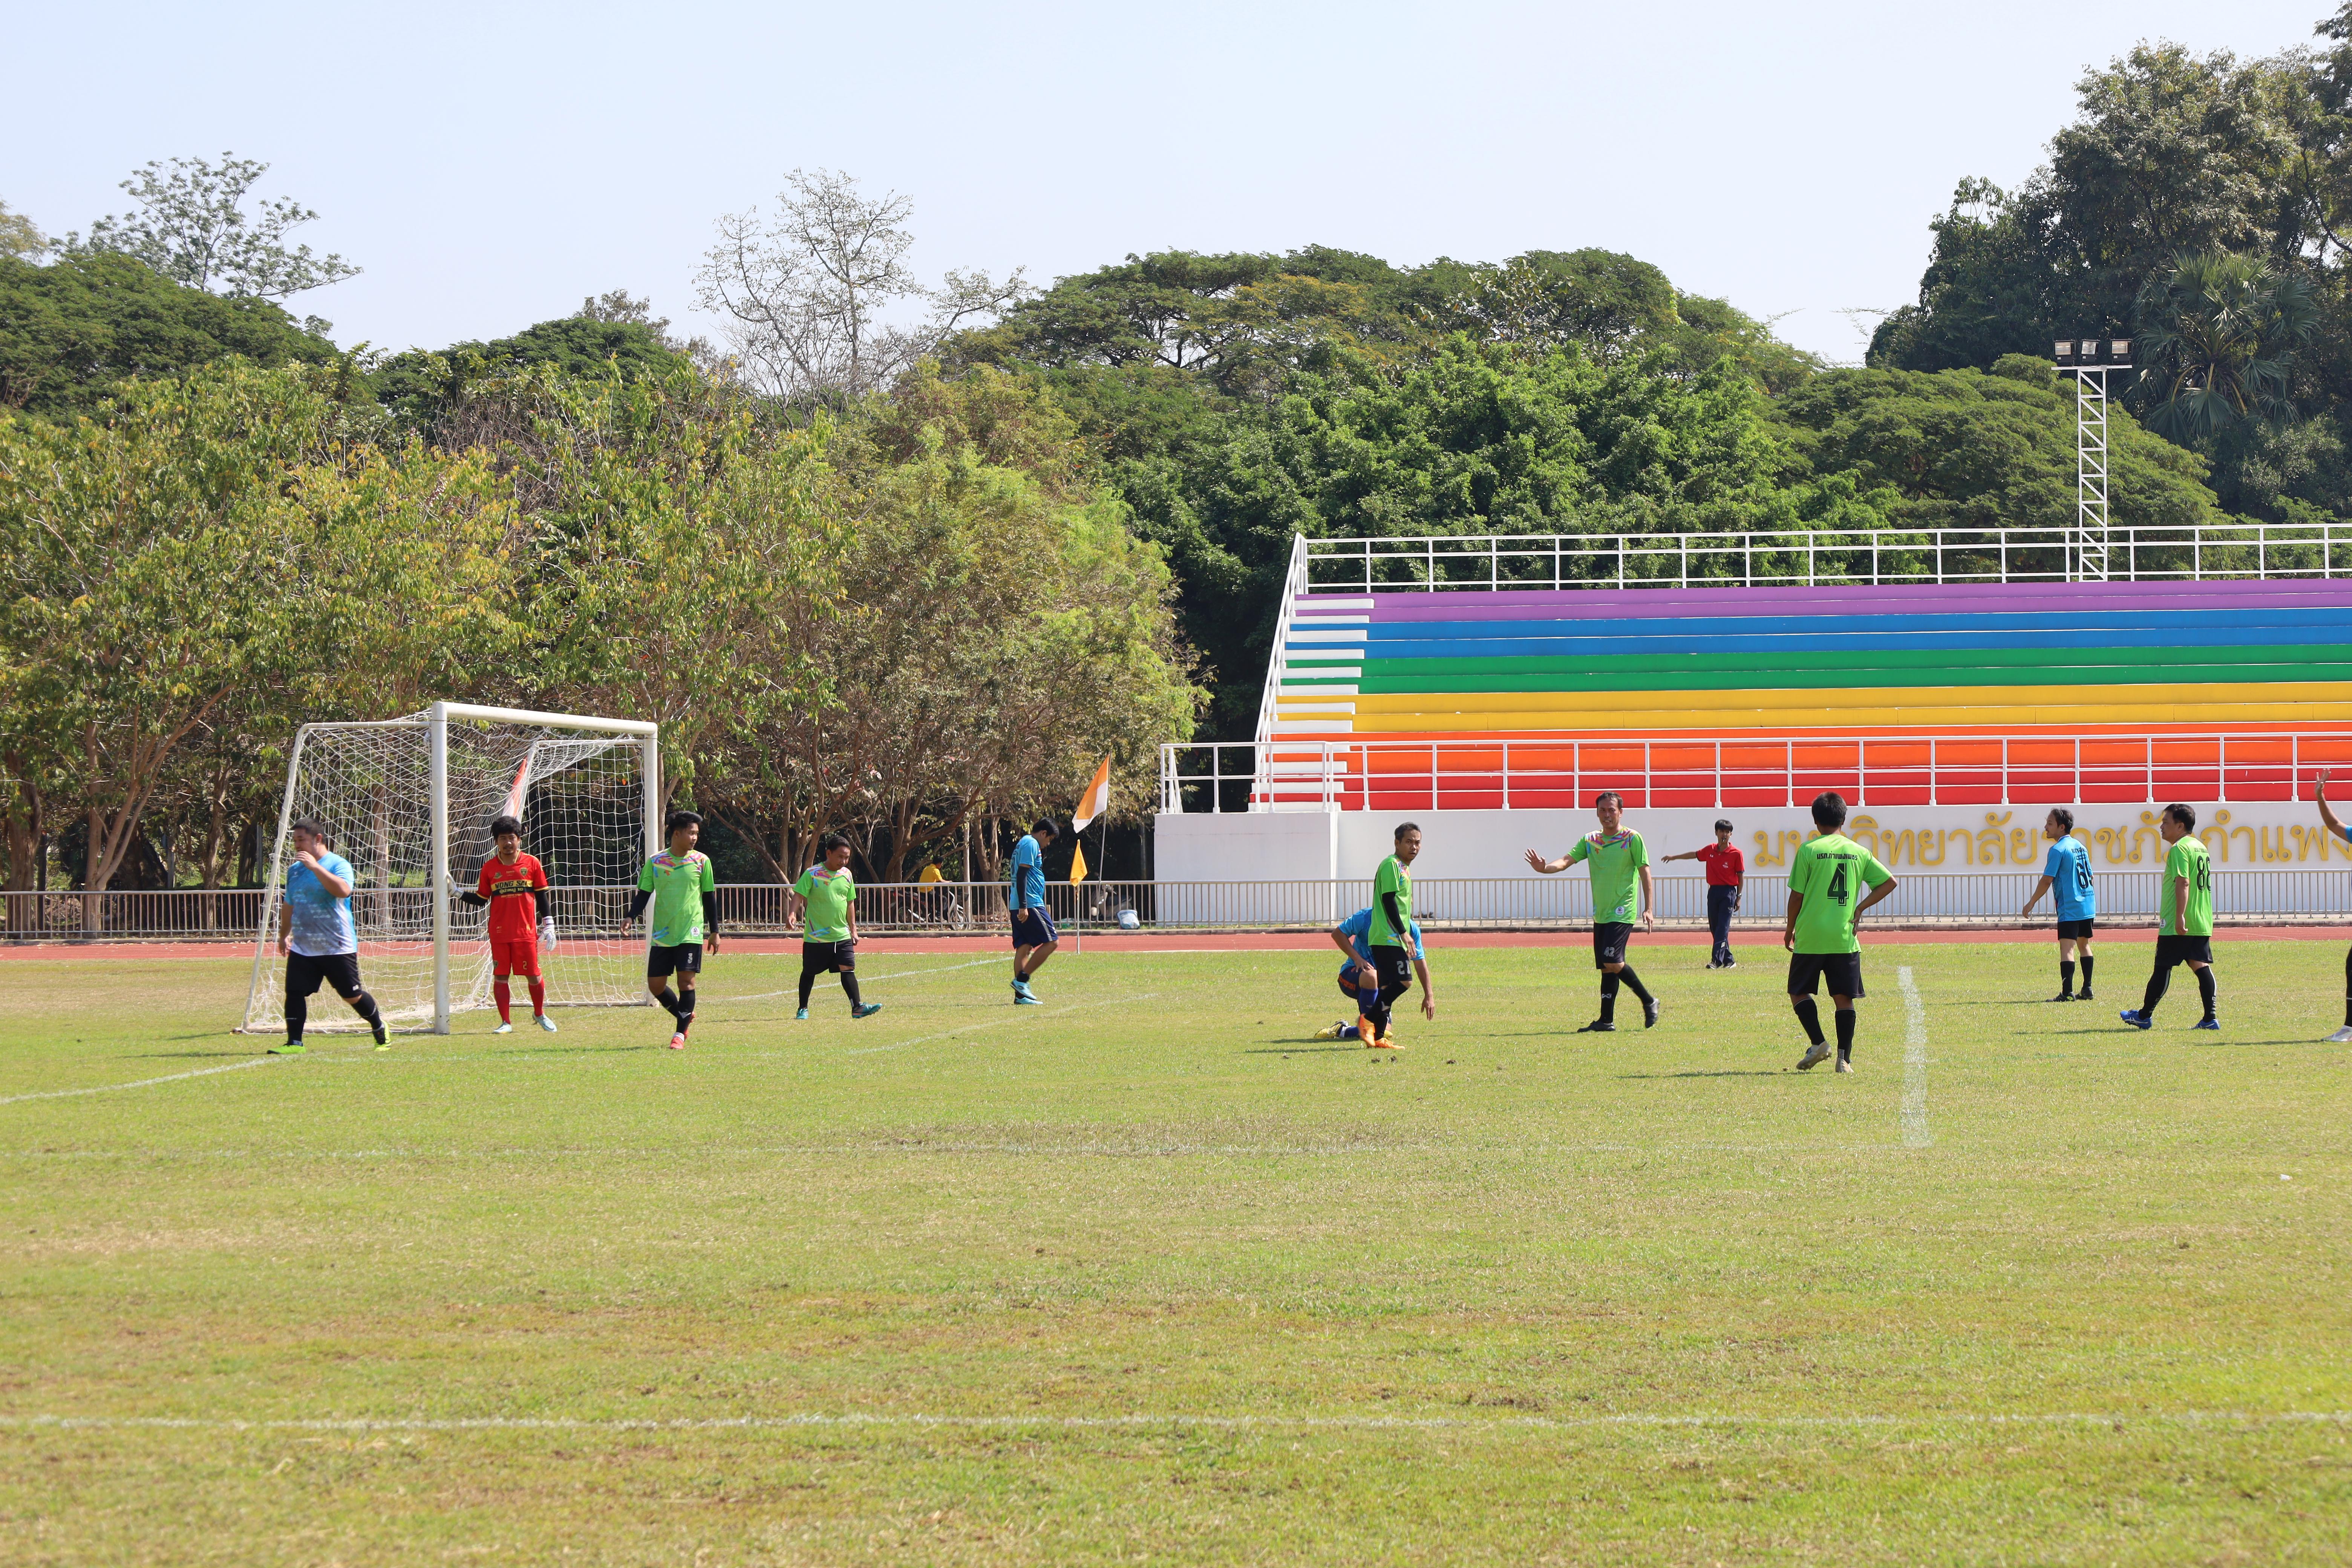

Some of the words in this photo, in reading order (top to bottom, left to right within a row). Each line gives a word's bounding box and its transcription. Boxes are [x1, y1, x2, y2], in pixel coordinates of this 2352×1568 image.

[1827, 863, 1849, 906] 4
[688, 952, 693, 963] 3
[1604, 947, 1615, 957] 42
[522, 961, 527, 970] 2
[1397, 960, 1410, 975] 21
